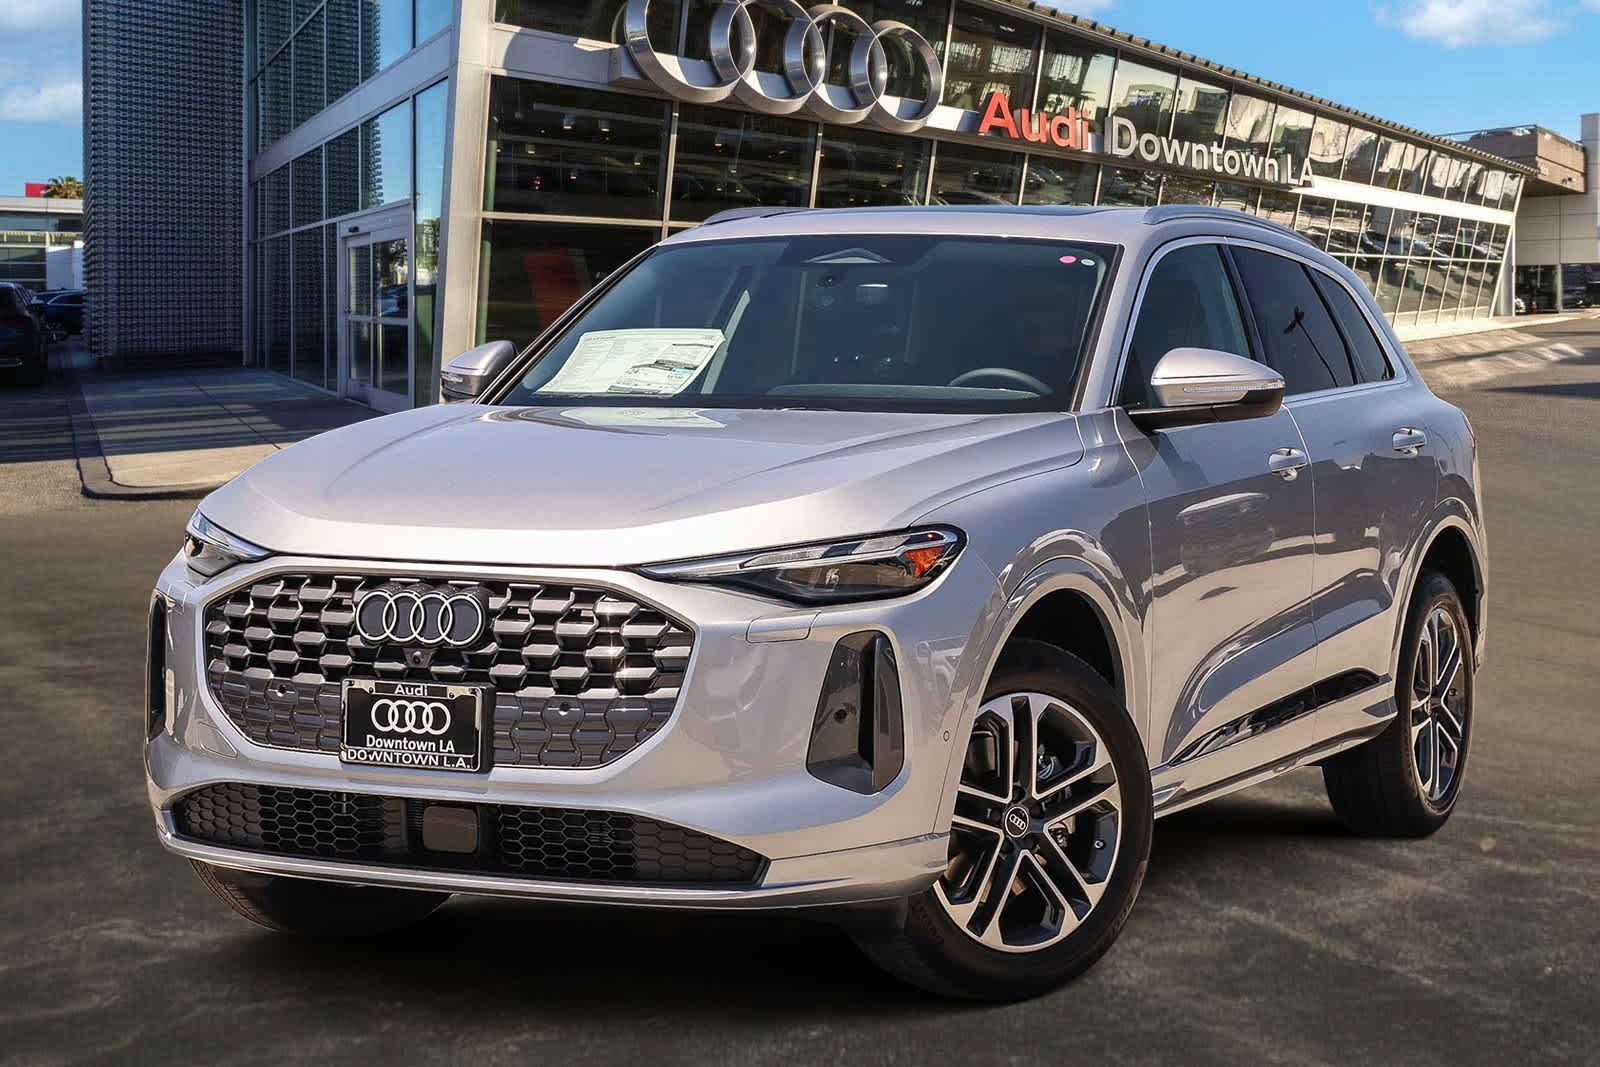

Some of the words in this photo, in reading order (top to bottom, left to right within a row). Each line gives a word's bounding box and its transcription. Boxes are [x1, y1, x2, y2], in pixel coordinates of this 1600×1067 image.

[977, 90, 1089, 150] Audi
[1106, 115, 1280, 183] Downtown
[1286, 153, 1316, 188] LA
[394, 683, 429, 697] Audi
[366, 734, 437, 752] Downtown
[439, 740, 455, 753] LA
[347, 748, 439, 767] DOWNTOWN
[443, 756, 472, 769] L.A.
